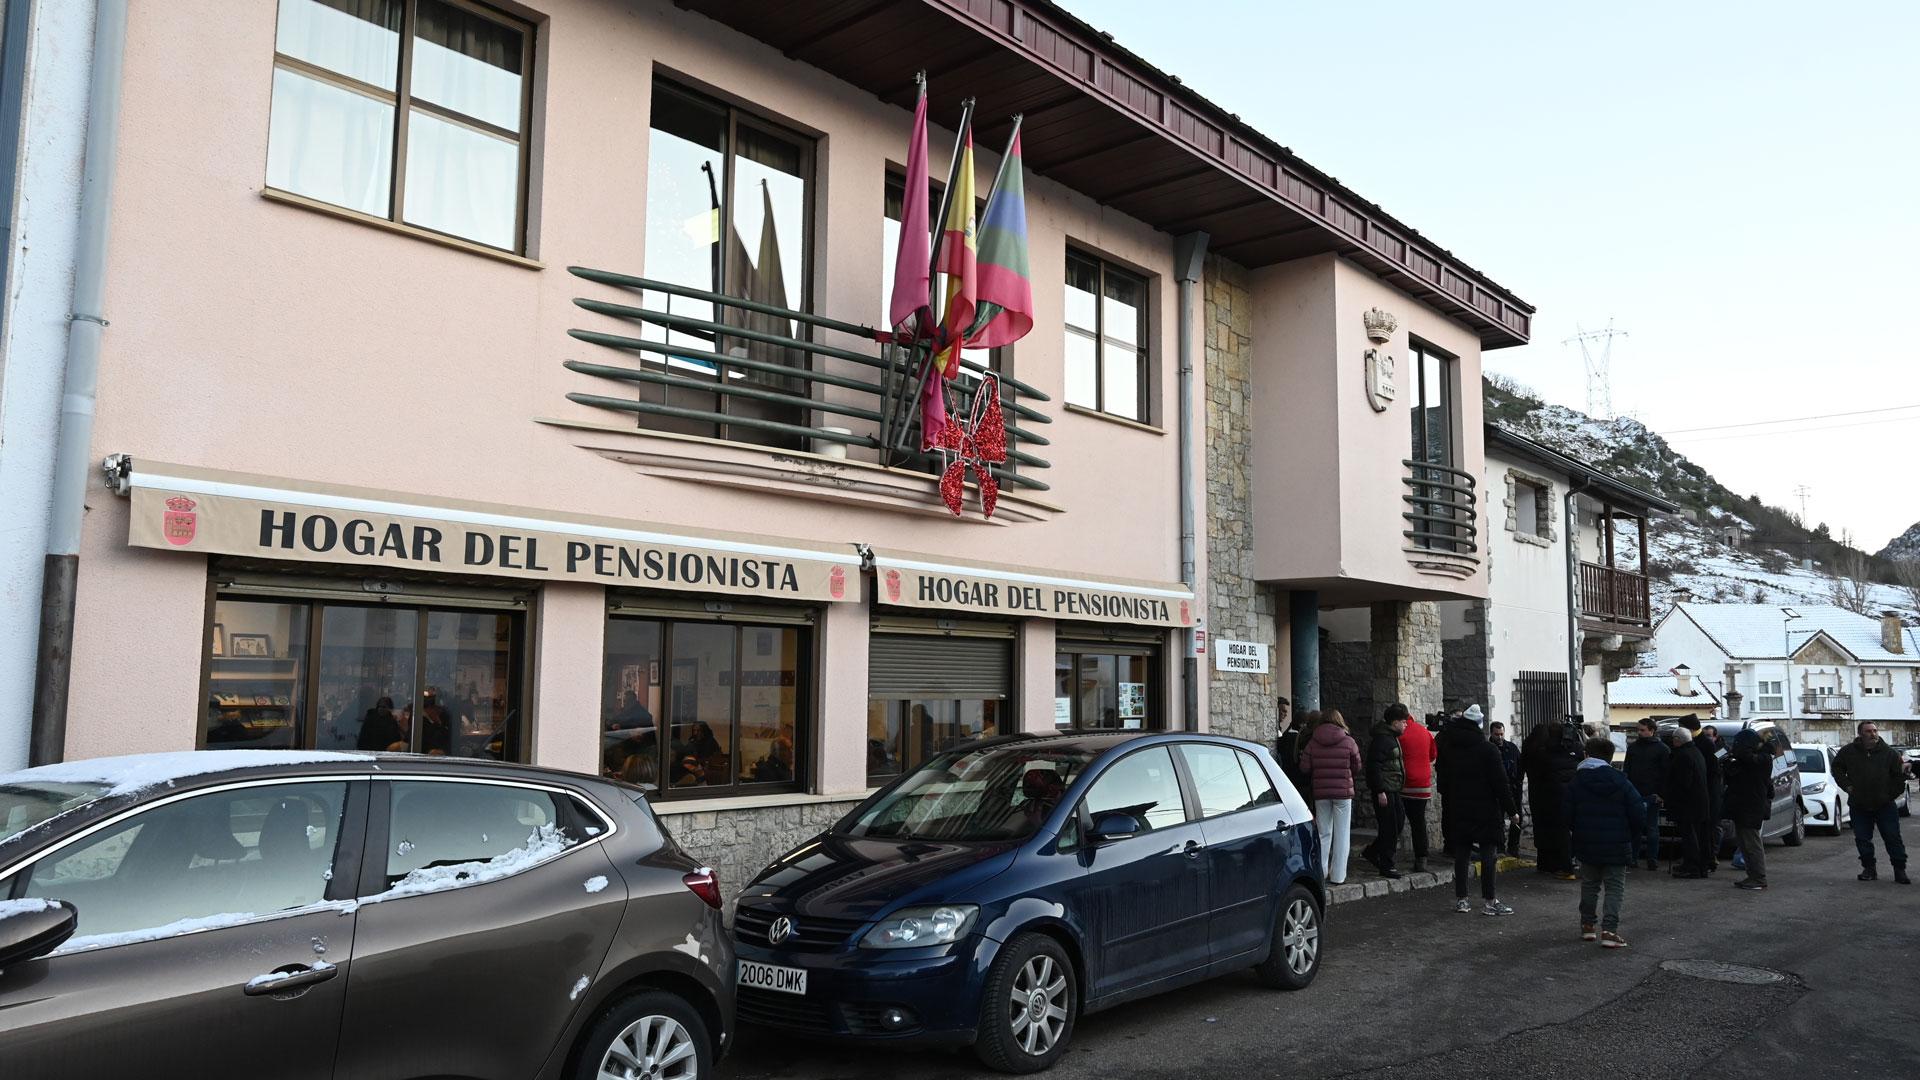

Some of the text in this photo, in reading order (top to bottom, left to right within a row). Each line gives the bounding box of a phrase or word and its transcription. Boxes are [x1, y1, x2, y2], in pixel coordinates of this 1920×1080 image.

[259, 509, 799, 592] HOGAR DEL PENSIONISTA
[918, 575, 1169, 621] HOGAR DEL PENSIONISTA
[1227, 657, 1260, 669] PENSIONISTA
[1228, 644, 1257, 656] HOGAR DEL
[741, 963, 802, 991] 2006 DMK
